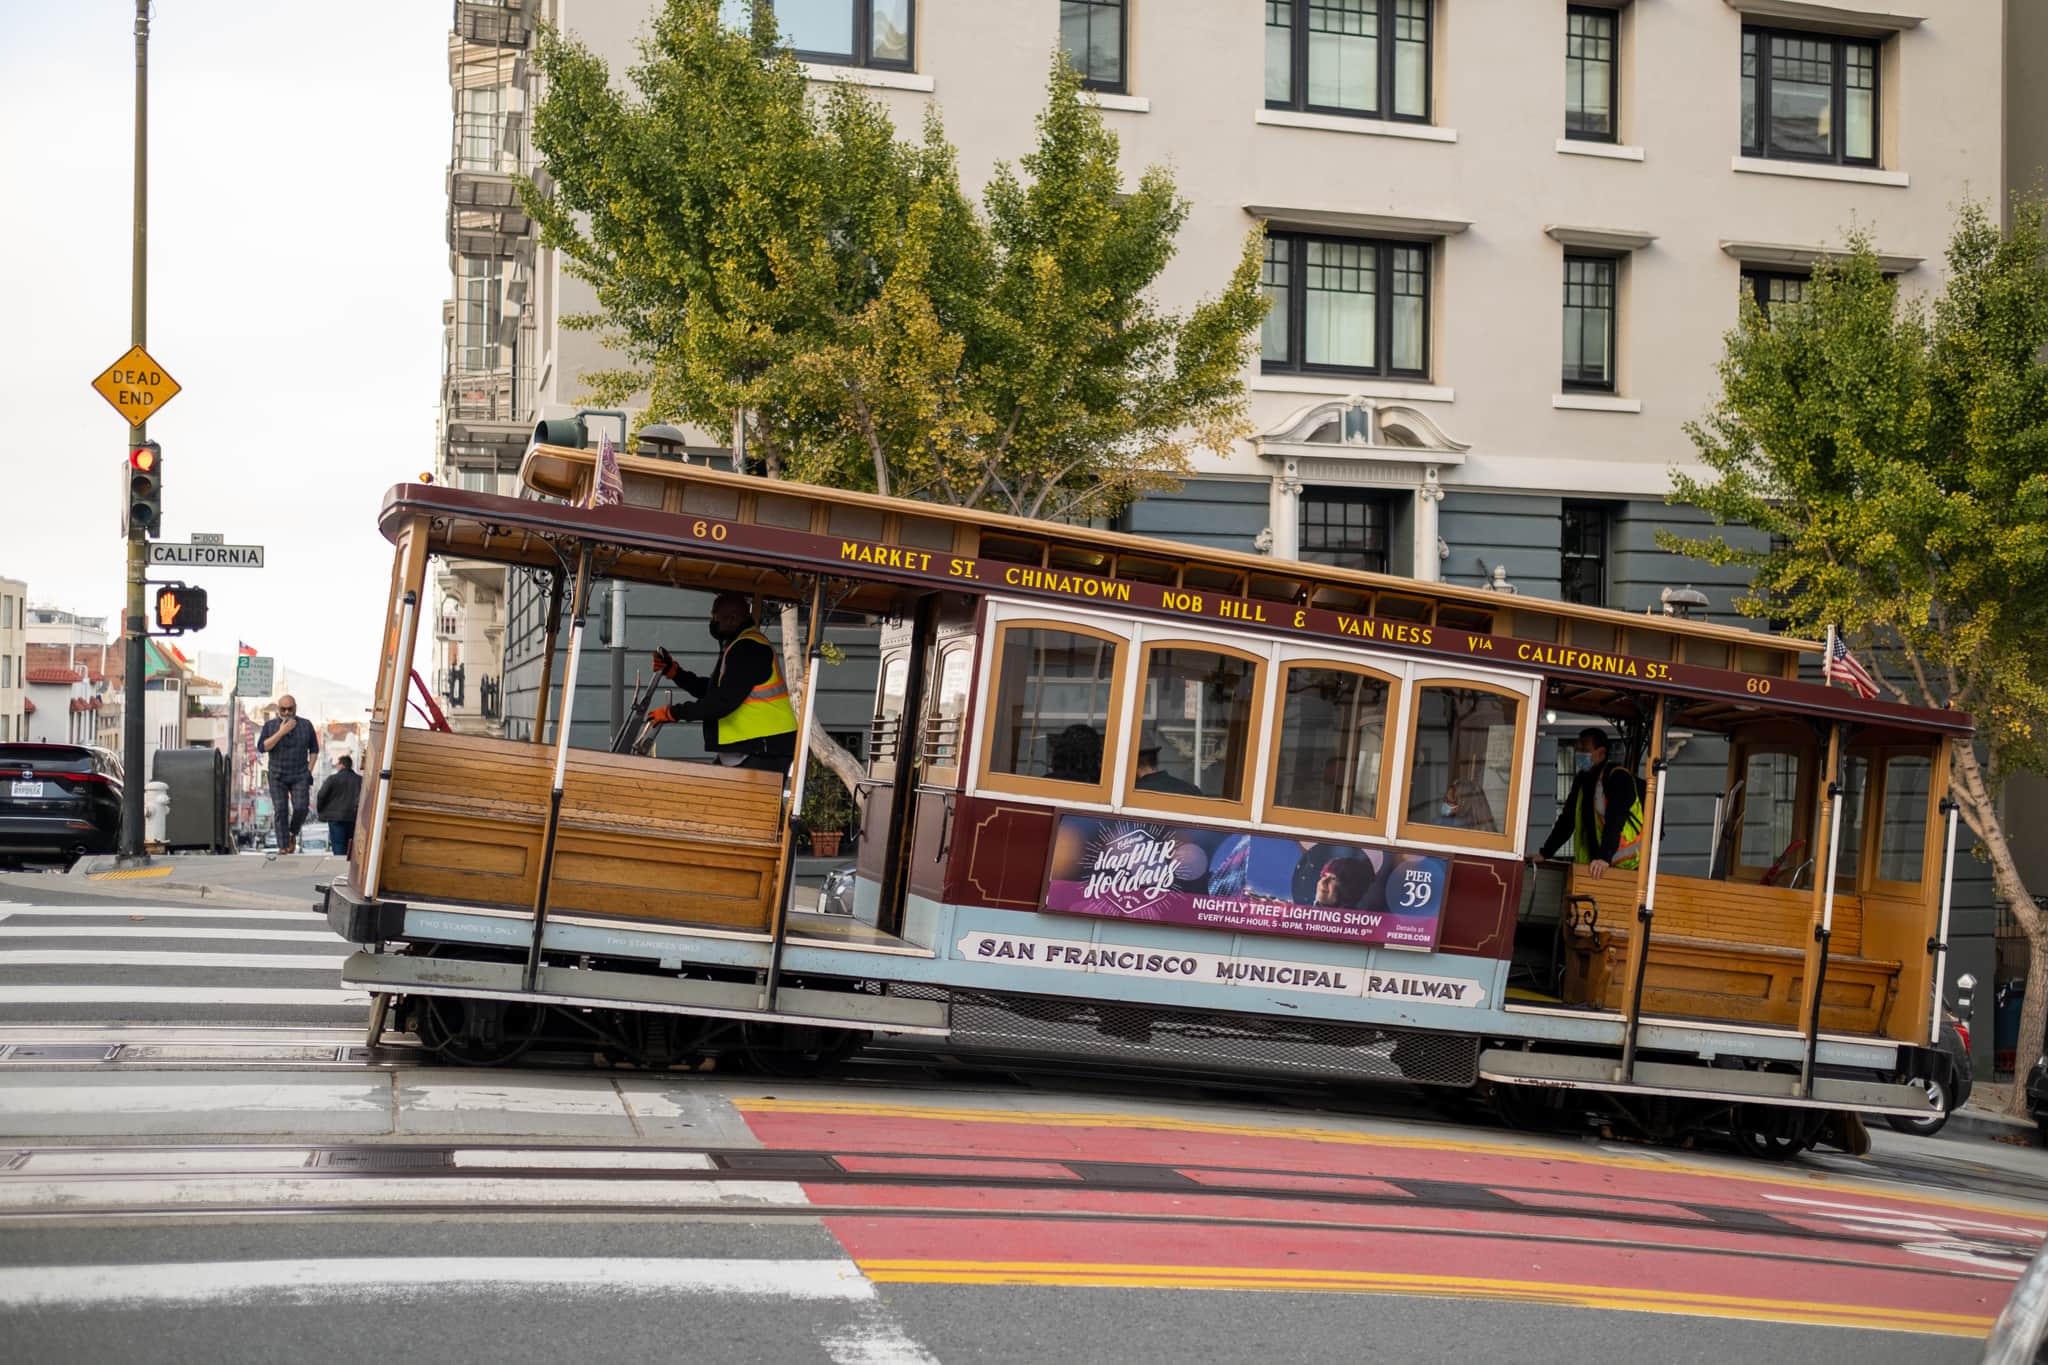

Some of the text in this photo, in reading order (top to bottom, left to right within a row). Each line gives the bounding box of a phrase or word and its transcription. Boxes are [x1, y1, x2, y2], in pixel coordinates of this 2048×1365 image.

[113, 370, 161, 386] DEAD
[119, 391, 154, 405] END
[692, 521, 727, 541] 60
[154, 547, 259, 564] CALIFORNIA
[841, 542, 931, 571] MARKET
[949, 559, 980, 580] ST.
[1006, 568, 1131, 601] CHINATOWN
[1162, 592, 1203, 613] NOB
[1219, 600, 1267, 622] HILL
[1337, 616, 1375, 637] VAN
[1382, 623, 1433, 645] NESS
[1468, 635, 1493, 653] VIA
[1518, 644, 1638, 677] CALIFORNIA
[1645, 663, 1673, 681] ST.
[240, 657, 249, 667] 2
[1746, 678, 1771, 694] 60
[1083, 859, 1181, 900] Holidays
[1405, 869, 1432, 883] PIER
[1399, 881, 1432, 908] 39
[1192, 898, 1382, 927] NIGHTLY TREE LIGHTING SHOW
[1197, 913, 1224, 922] EVERY
[1224, 915, 1246, 925] HALF
[1305, 923, 1342, 934] THROUGH
[978, 938, 1468, 1001] SAN FRANCISCO MUNICIPAL RAILWAY
